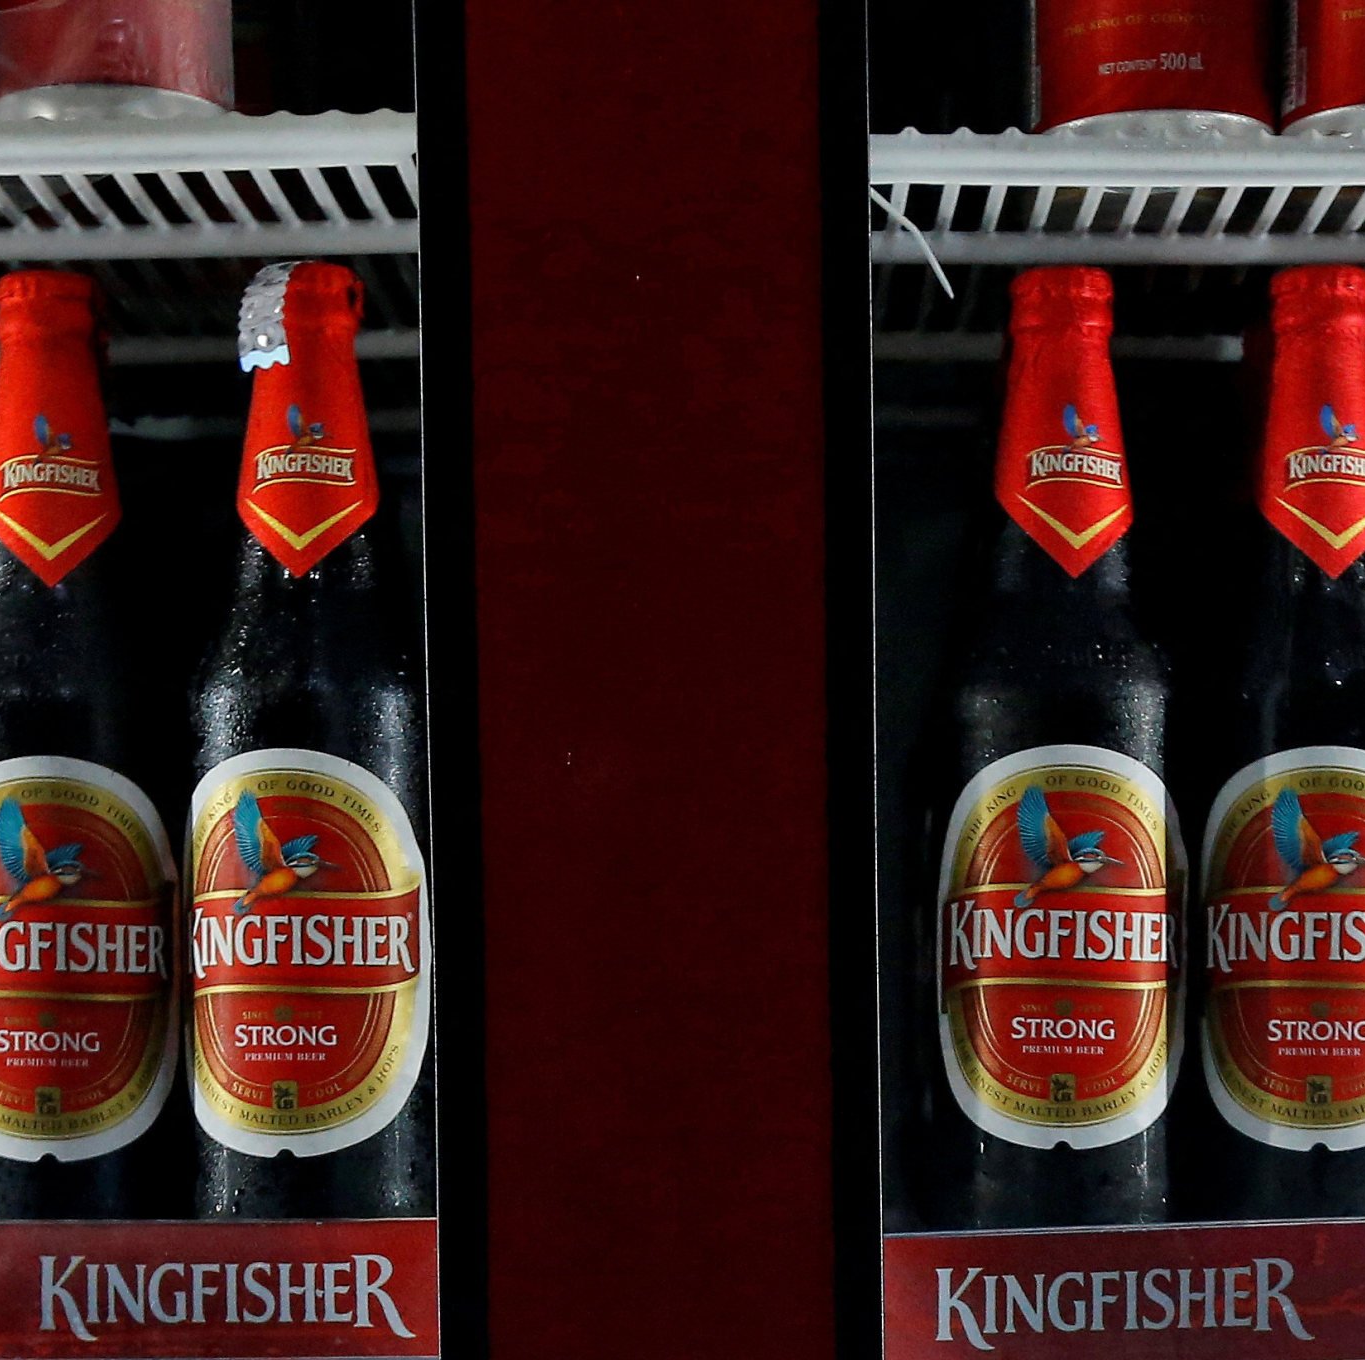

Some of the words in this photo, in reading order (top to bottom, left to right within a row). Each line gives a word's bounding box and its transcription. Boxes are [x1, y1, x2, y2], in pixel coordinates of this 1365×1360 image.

[1160, 53, 1186, 71] 500
[2, 461, 101, 492] KINGFISHER
[256, 451, 354, 481] KINGFISHER
[1031, 453, 1122, 484] KINGFISHER
[257, 780, 278, 792] OF
[286, 779, 335, 798] GOOD
[342, 793, 382, 834] TIMES
[987, 787, 1017, 813] KING
[1045, 775, 1065, 787] OF
[1075, 775, 1121, 794] GOOD
[1128, 791, 1158, 830] TIMES
[189, 905, 416, 978] KINGFISHER
[949, 900, 1177, 970] KINGFISHER
[234, 1024, 337, 1047] STRONG
[1010, 1016, 1115, 1041] STRONG
[6, 1057, 57, 1067] PREMIUM
[60, 1057, 89, 1067] BEER
[244, 1052, 293, 1062] PREMIUM
[296, 1052, 326, 1061] BEER
[1022, 1044, 1073, 1055] PREMIUM
[1076, 1045, 1105, 1055] BEER
[1278, 1047, 1330, 1056] PREMIUM
[1332, 1047, 1361, 1057] BEER
[239, 1109, 298, 1125] MALTED
[306, 1095, 363, 1124] BARLEY
[377, 1044, 399, 1084] HOPS
[970, 1067, 1008, 1105] FINEST
[1013, 1101, 1076, 1117] MALTED
[1082, 1088, 1136, 1116] BARLEY
[39, 1255, 416, 1341] KINGFISHER
[934, 1257, 1315, 1352] KINGFISHER
